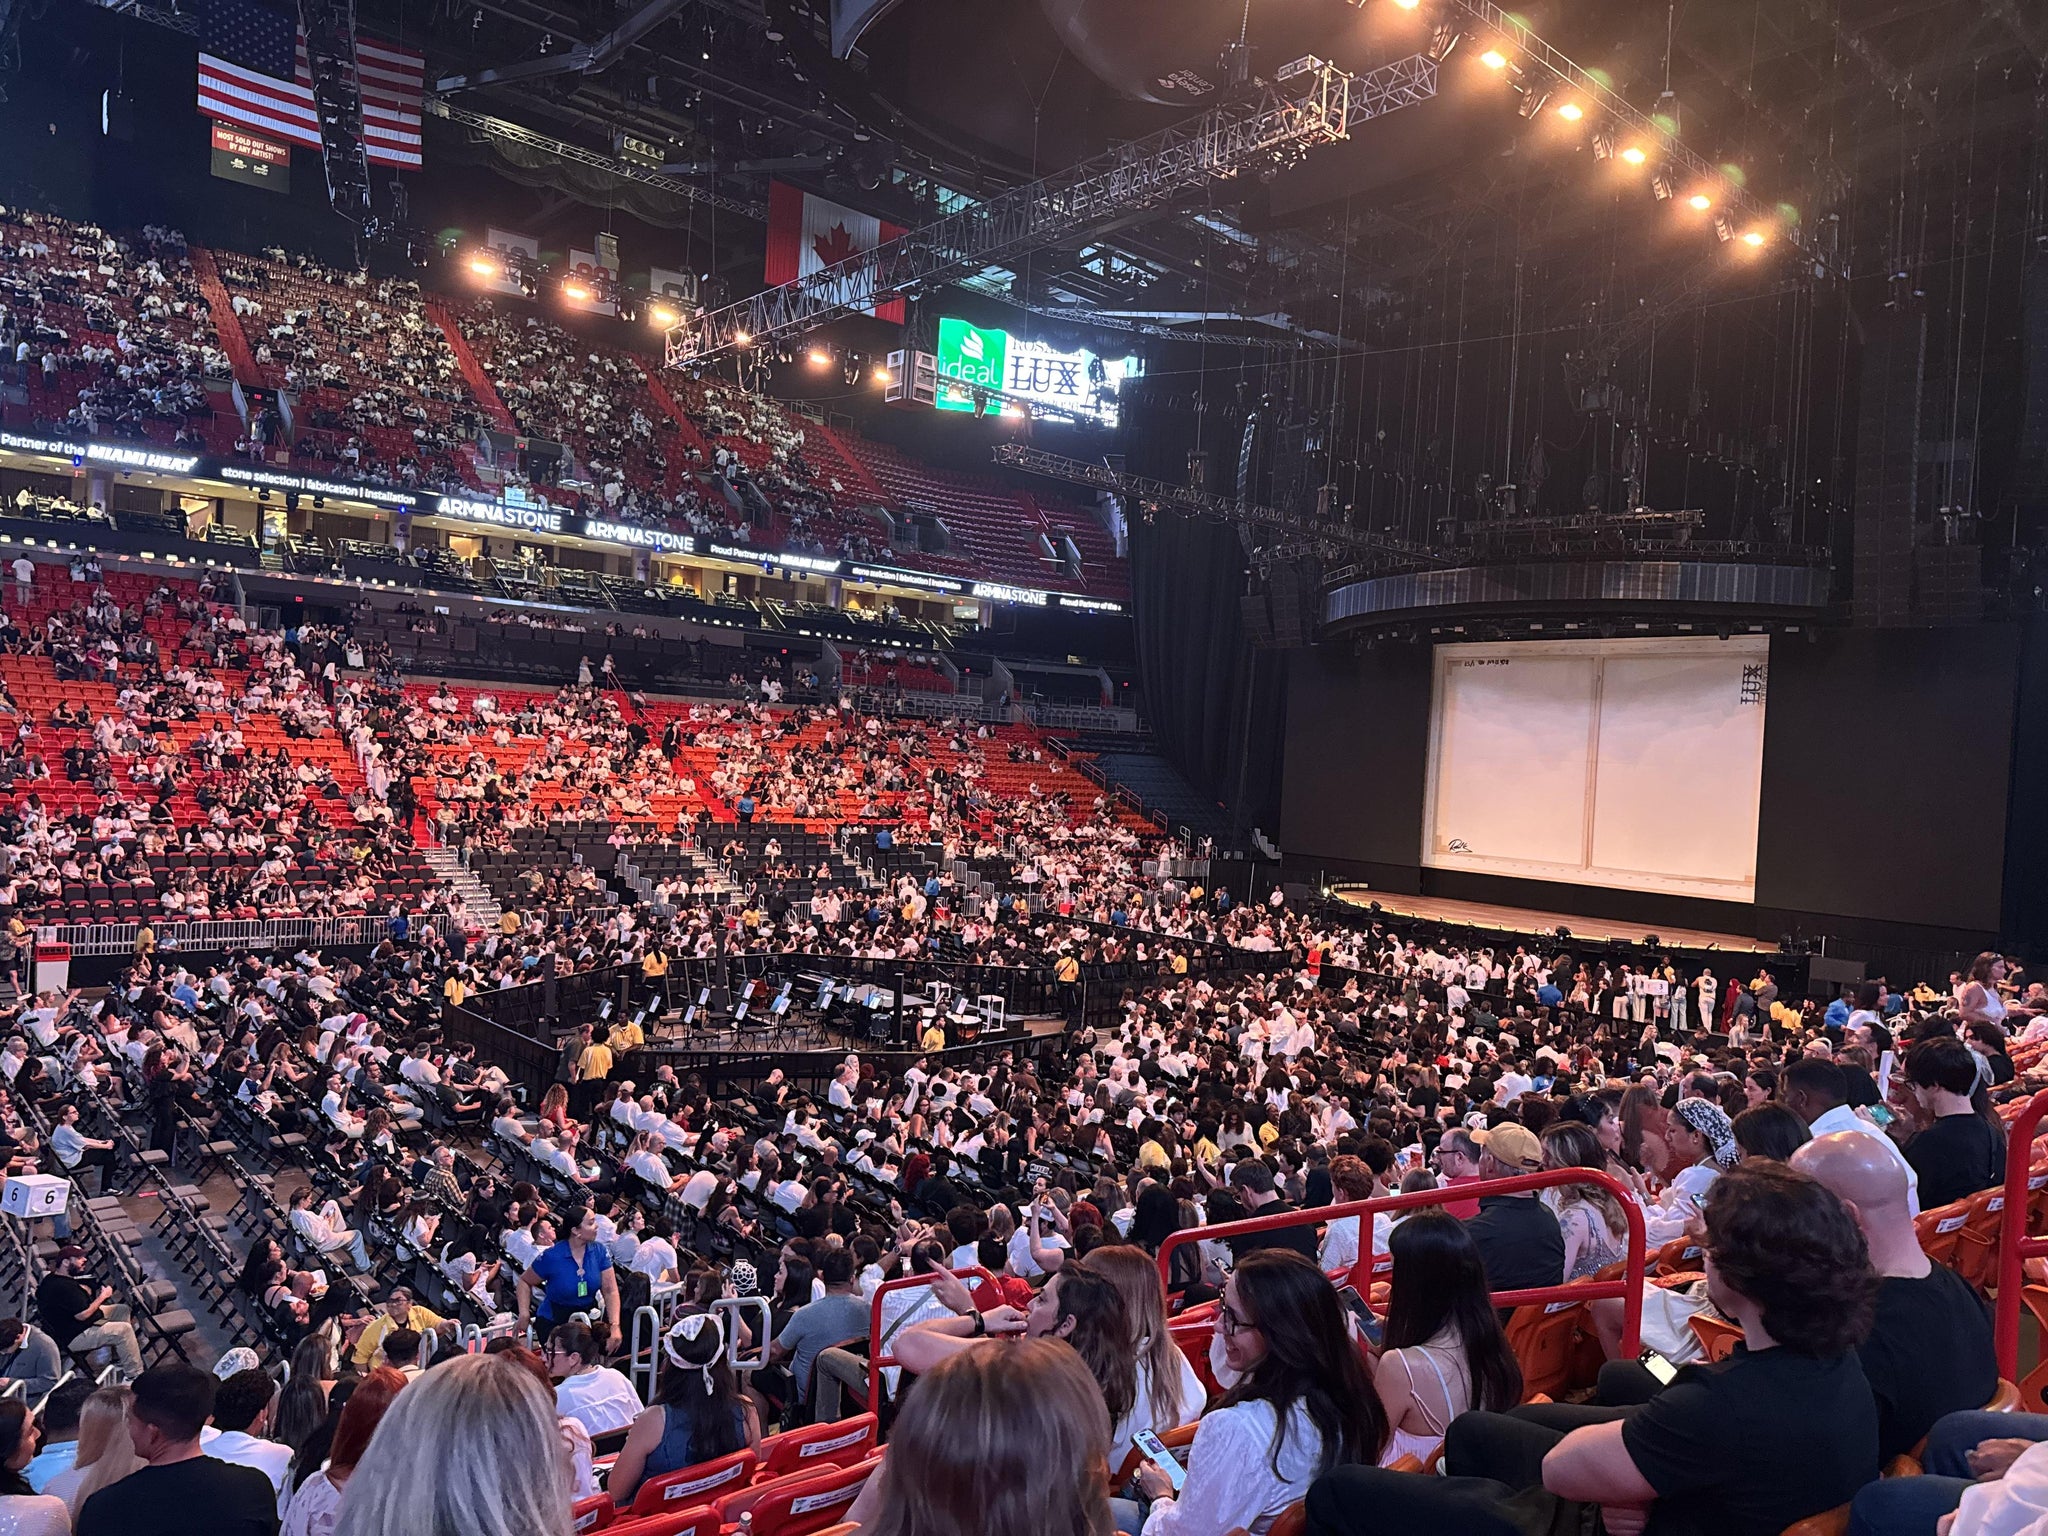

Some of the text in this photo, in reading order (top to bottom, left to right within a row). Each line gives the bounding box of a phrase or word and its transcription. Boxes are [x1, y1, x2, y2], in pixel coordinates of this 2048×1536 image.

[1168, 73, 1204, 96] Kaseya
[1178, 70, 1215, 91] Center
[216, 131, 286, 155] MOST SOLD OUT SHOWS
[238, 145, 251, 154] ANY
[251, 149, 274, 160] ARTIST!
[941, 354, 998, 385] ideal
[1009, 355, 1081, 396] LUX
[1, 433, 198, 472] Partner of the MIAMI HEAT
[221, 467, 416, 505] stone selection fabrication installation
[710, 544, 732, 556] Proud
[733, 548, 758, 560] Partner
[767, 553, 779, 563] the
[1740, 664, 1763, 705] LUX
[11, 1187, 19, 1202] 6
[45, 1190, 56, 1205] 6
